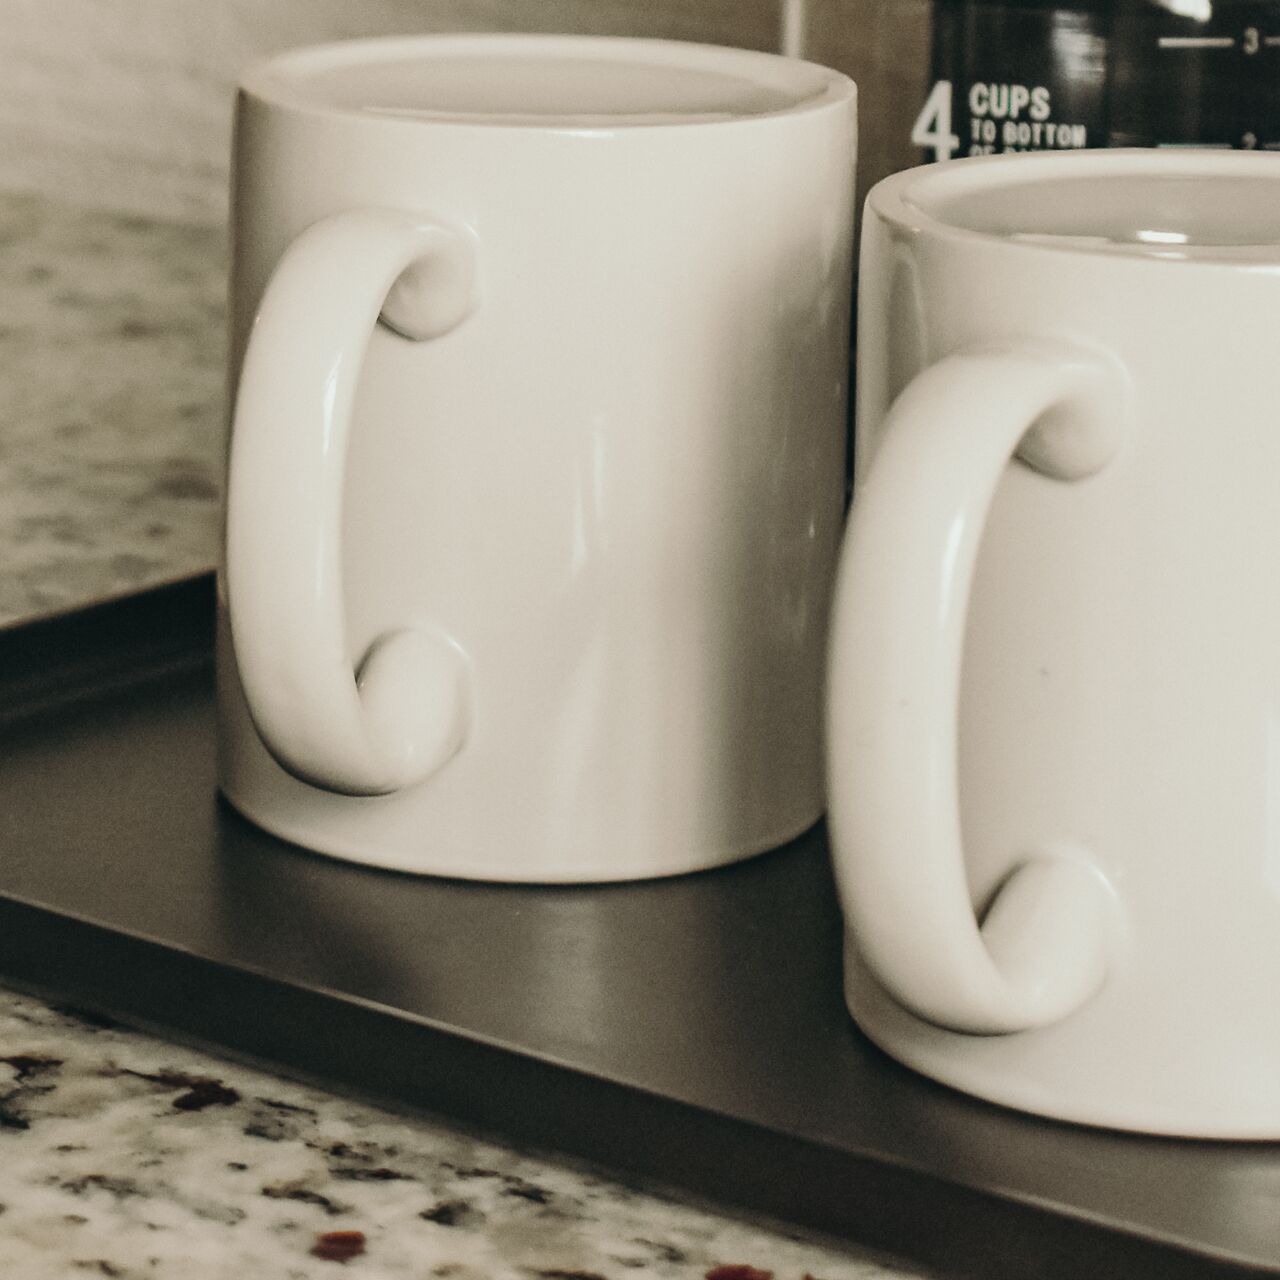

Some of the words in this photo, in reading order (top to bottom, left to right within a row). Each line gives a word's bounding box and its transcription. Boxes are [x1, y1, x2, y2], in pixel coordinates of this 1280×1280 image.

[911, 79, 961, 162] 4
[969, 81, 1051, 121] CUPS
[970, 117, 997, 143] TO
[1002, 120, 1088, 149] BOTTOM
